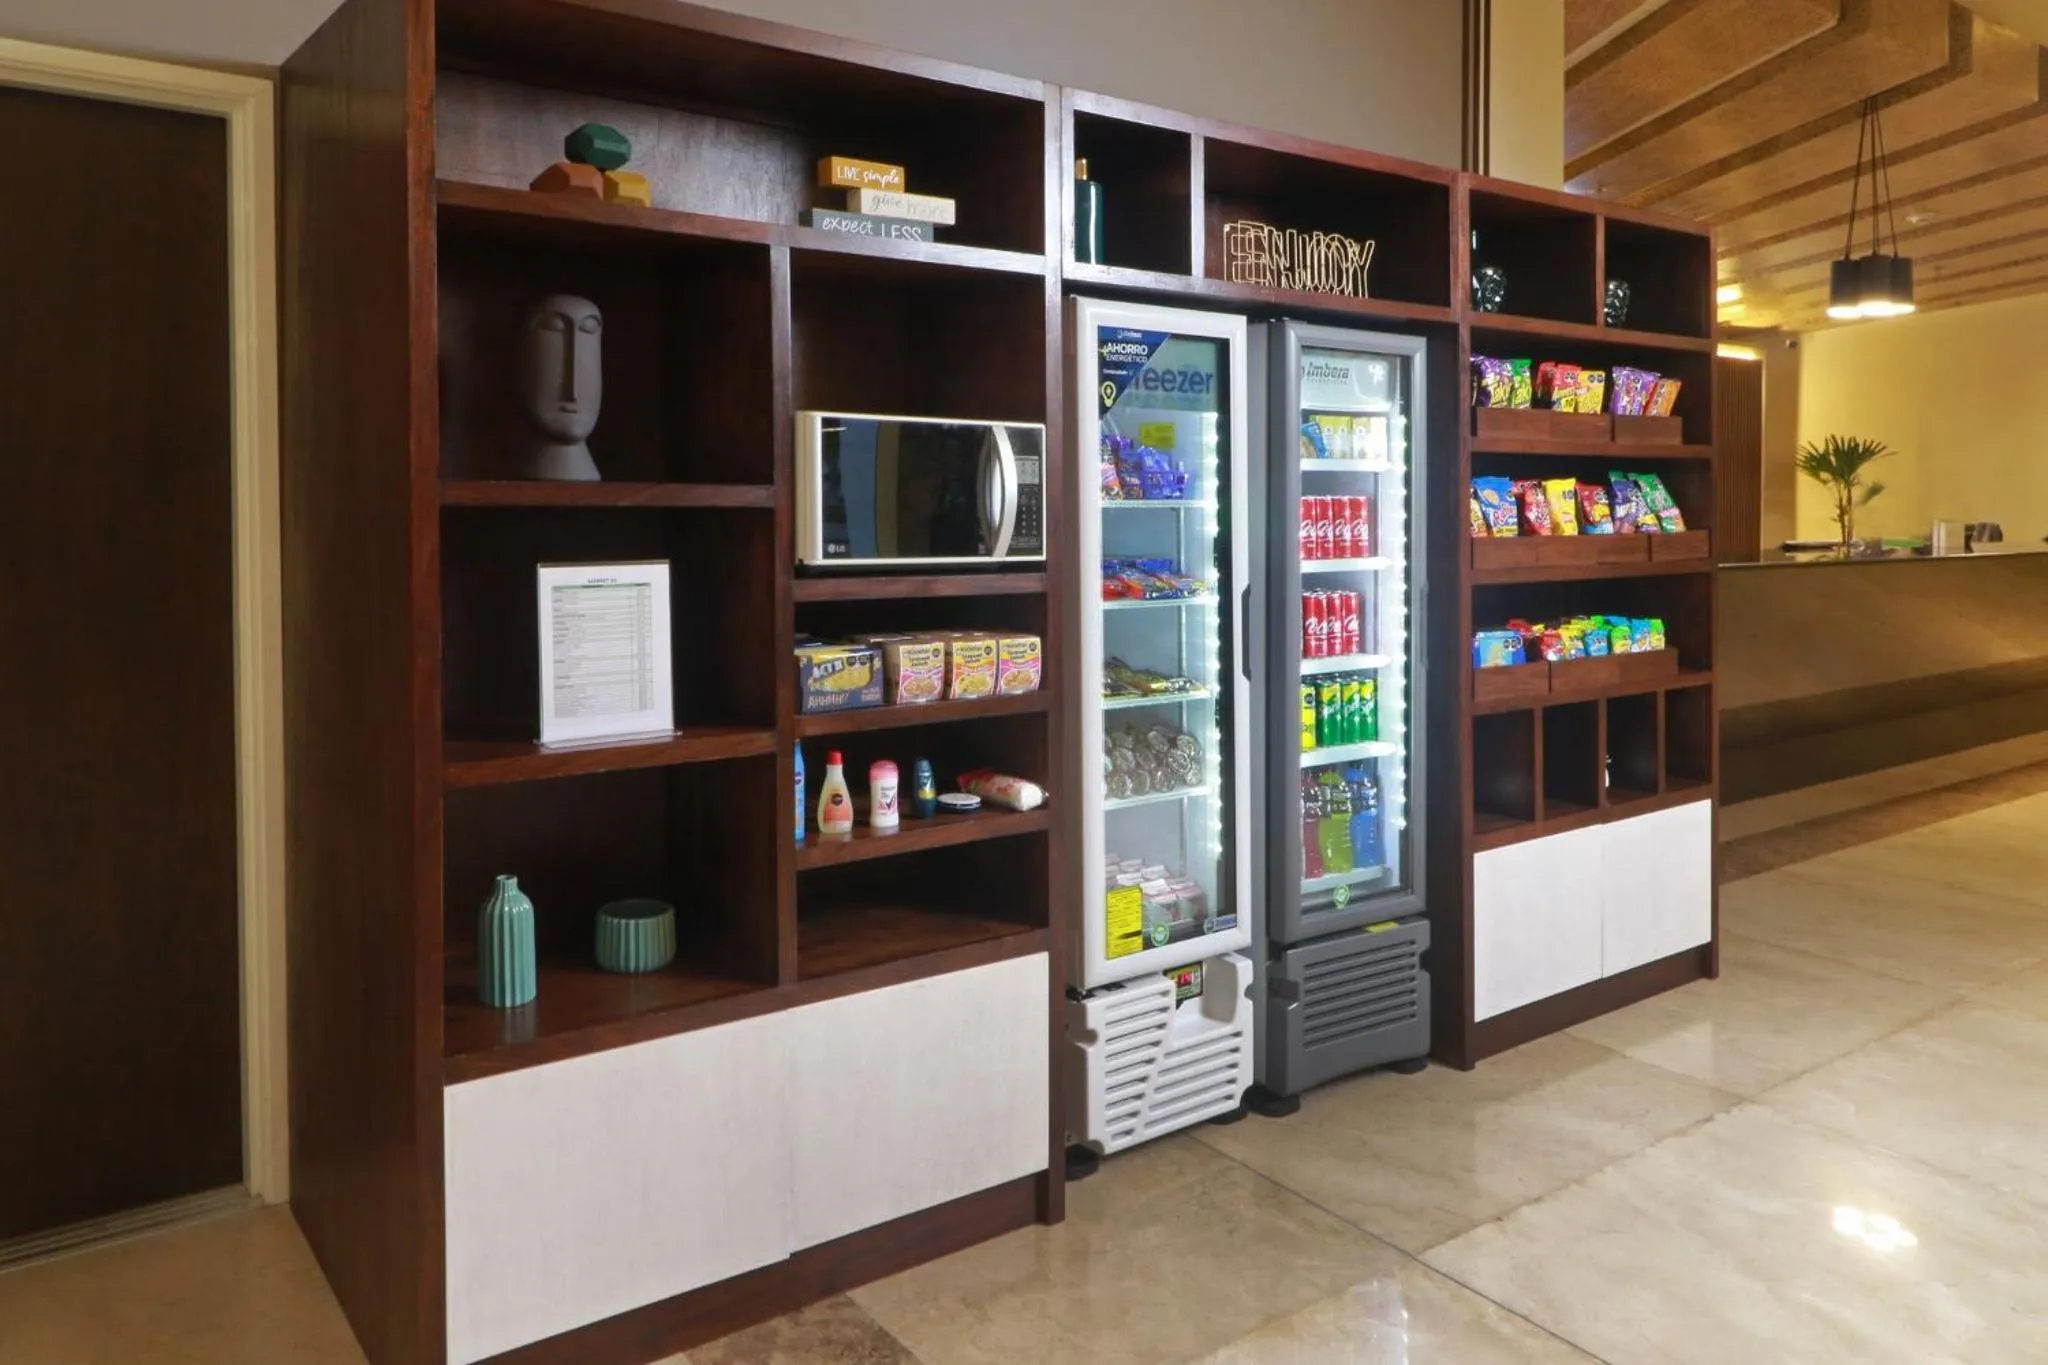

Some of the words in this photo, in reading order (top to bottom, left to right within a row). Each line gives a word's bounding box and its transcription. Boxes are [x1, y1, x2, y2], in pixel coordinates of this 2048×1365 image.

[836, 165, 860, 181] LIVE
[862, 168, 900, 188] simple
[822, 216, 875, 235] expect
[1106, 342, 1149, 355] AHORRO
